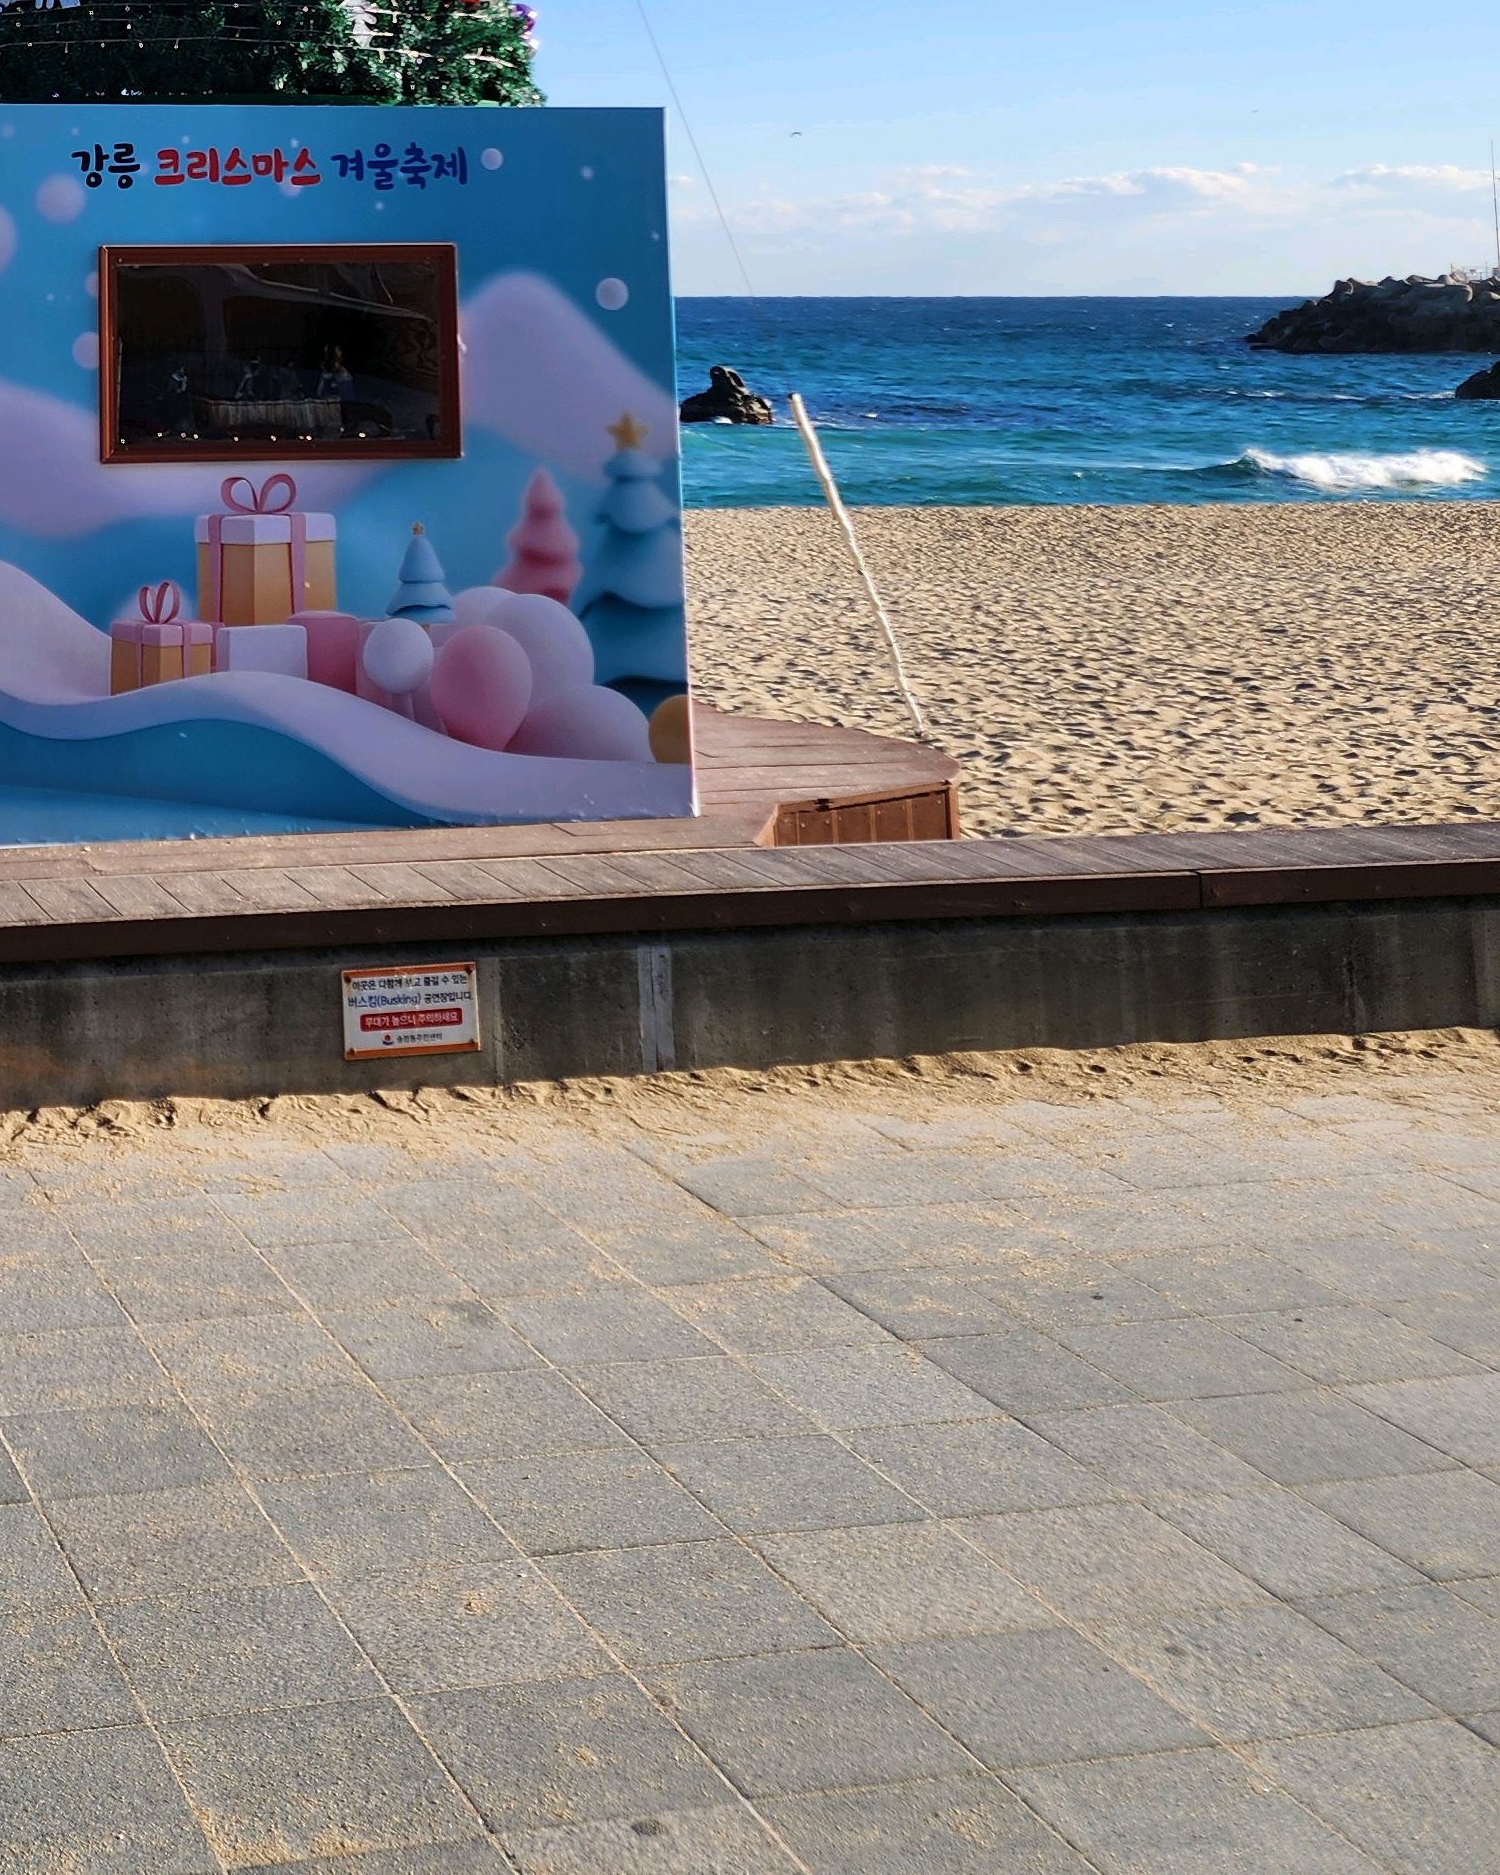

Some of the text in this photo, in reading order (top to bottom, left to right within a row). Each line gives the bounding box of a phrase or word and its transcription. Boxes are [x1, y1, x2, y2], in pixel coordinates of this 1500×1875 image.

[71, 141, 468, 191] 강릉 크리스마스 겨울축제
[441, 974, 450, 986] 수
[451, 974, 468, 985] 있는
[365, 1012, 459, 1028] 무대가 높으니 주의하세요
